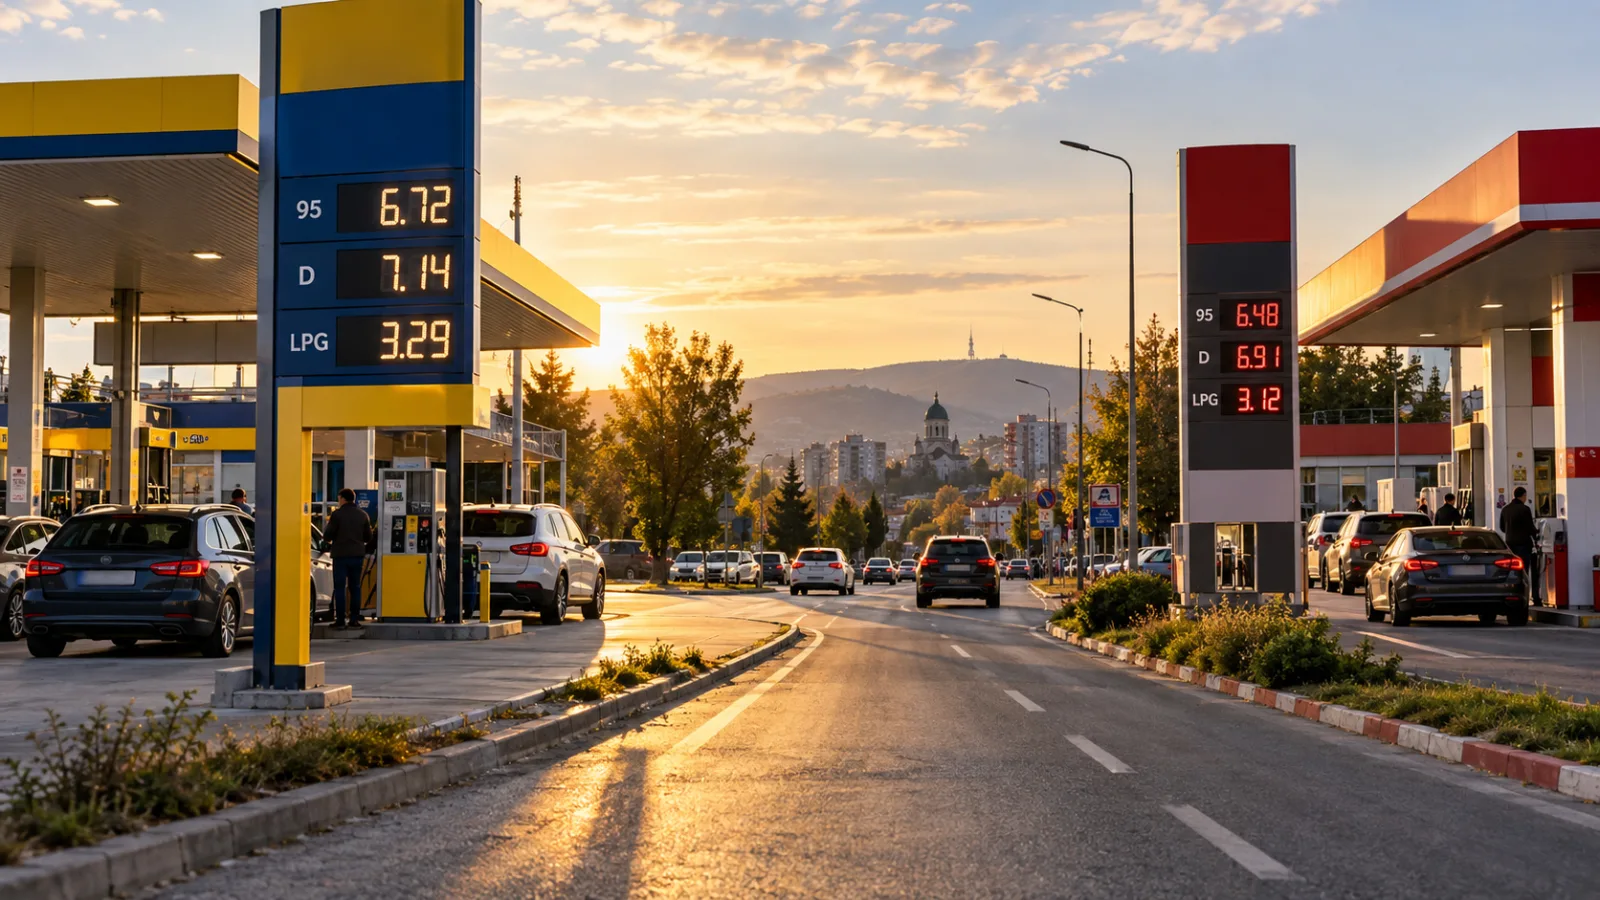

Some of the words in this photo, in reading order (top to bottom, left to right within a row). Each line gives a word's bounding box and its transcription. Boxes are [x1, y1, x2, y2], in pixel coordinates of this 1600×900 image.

[296, 200, 322, 219] 95
[380, 185, 451, 226] 6.72
[299, 265, 316, 286] D
[382, 254, 451, 292] 7.14
[1196, 308, 1214, 322] 95
[1236, 303, 1279, 327] 6.48
[290, 332, 329, 352] LPG
[380, 319, 451, 360] 3.29
[1198, 350, 1210, 364] D
[1237, 345, 1280, 369] 6.91
[1192, 393, 1219, 407] LPG
[1238, 387, 1280, 411] 3.12
